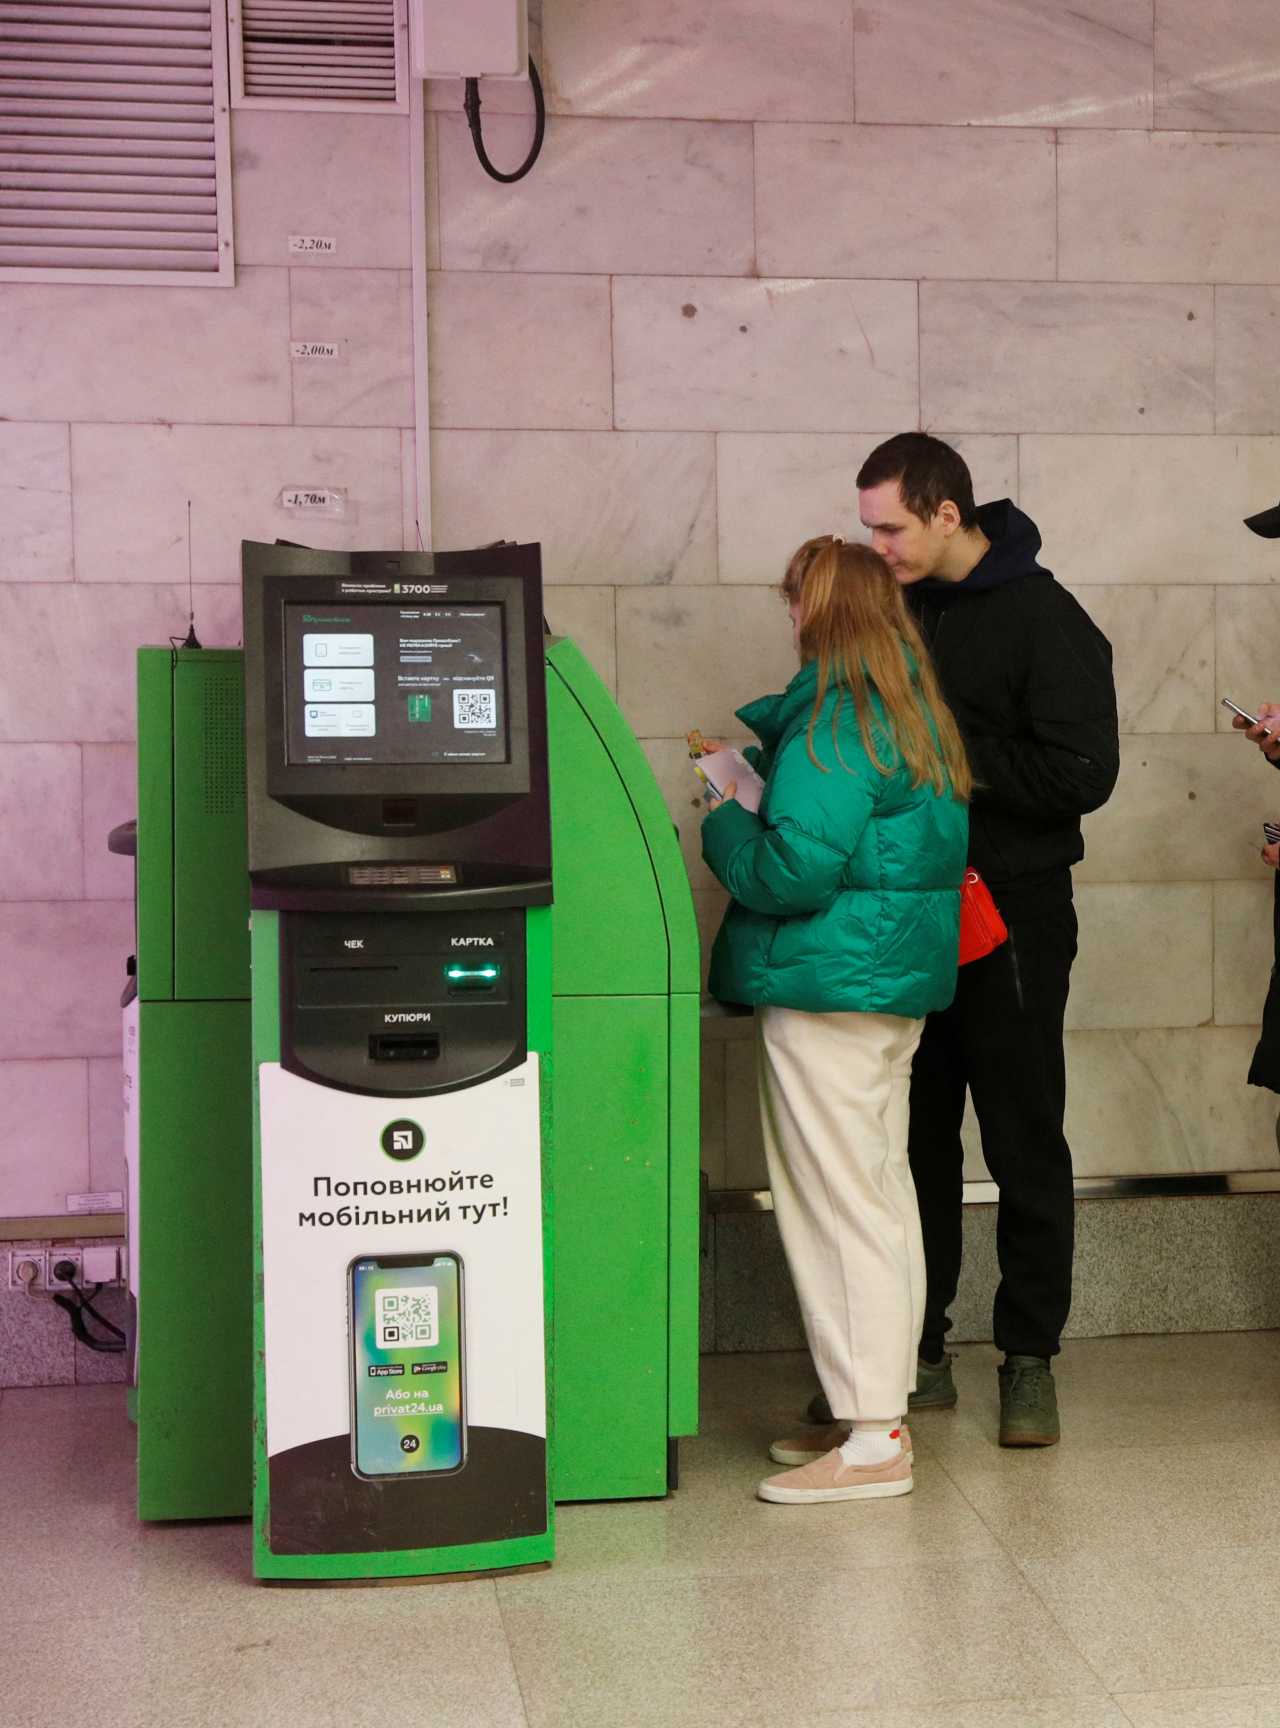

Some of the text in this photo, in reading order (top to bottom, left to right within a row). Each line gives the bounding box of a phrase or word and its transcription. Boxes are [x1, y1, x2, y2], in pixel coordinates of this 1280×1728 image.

[292, 239, 332, 252] -2,20м
[294, 344, 334, 357] -2,00м
[287, 493, 327, 506] -1,70м
[401, 584, 431, 594] 3700
[344, 939, 364, 949] ЧЕК
[451, 937, 494, 947] КАРТКА
[384, 1013, 431, 1024] КУПЮРИ
[313, 1170, 494, 1198] Поповнюйте
[298, 1197, 509, 1228] мобільний тут!
[386, 1389, 430, 1400] Або на
[373, 1402, 445, 1416] privat24.ua
[403, 1439, 418, 1449] 24
